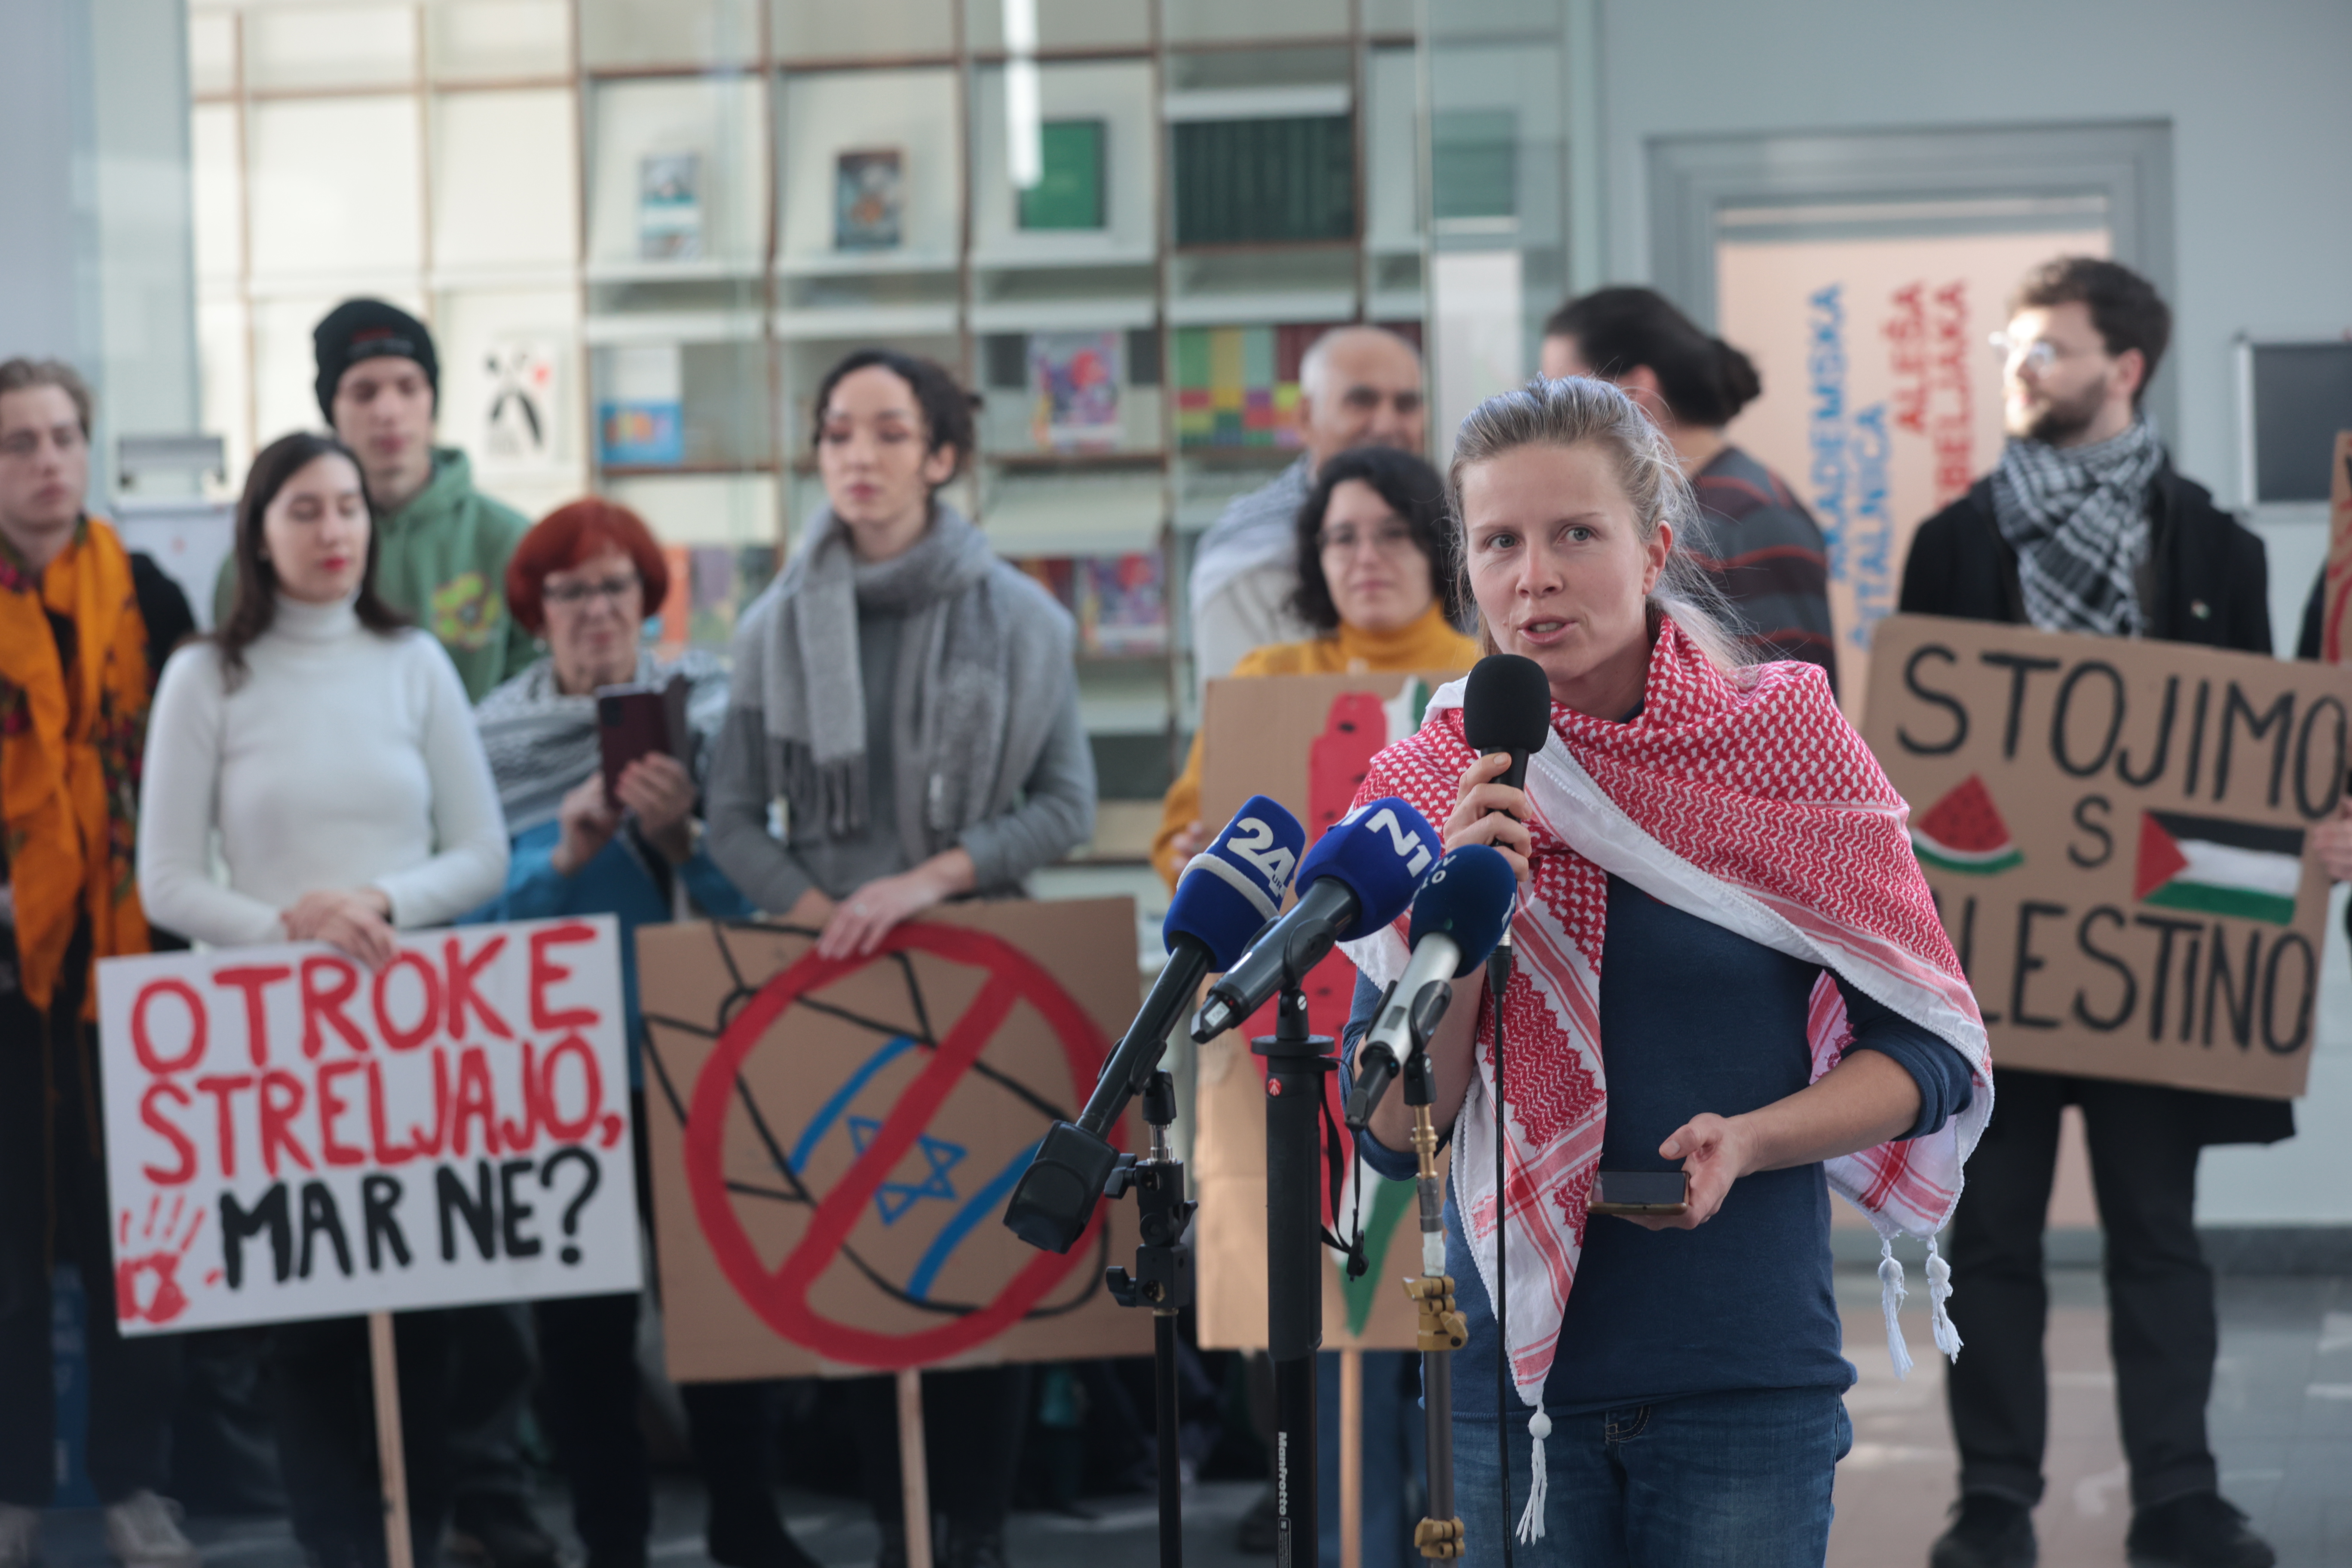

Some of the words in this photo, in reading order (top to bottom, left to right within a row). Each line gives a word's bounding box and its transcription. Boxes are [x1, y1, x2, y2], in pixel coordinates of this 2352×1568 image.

[1896, 643, 2346, 820] STOJIMO
[1271, 874, 1283, 891] UR
[1365, 808, 1432, 878] N1
[2068, 793, 2114, 869] S
[130, 919, 601, 1076] OTROKE
[1932, 888, 2317, 1056] LESTINO
[139, 1034, 625, 1186] STRELJAJO,
[219, 1171, 412, 1290] MAR
[435, 1146, 601, 1265] NE?
[1278, 1431, 1288, 1516] Manfrotto
